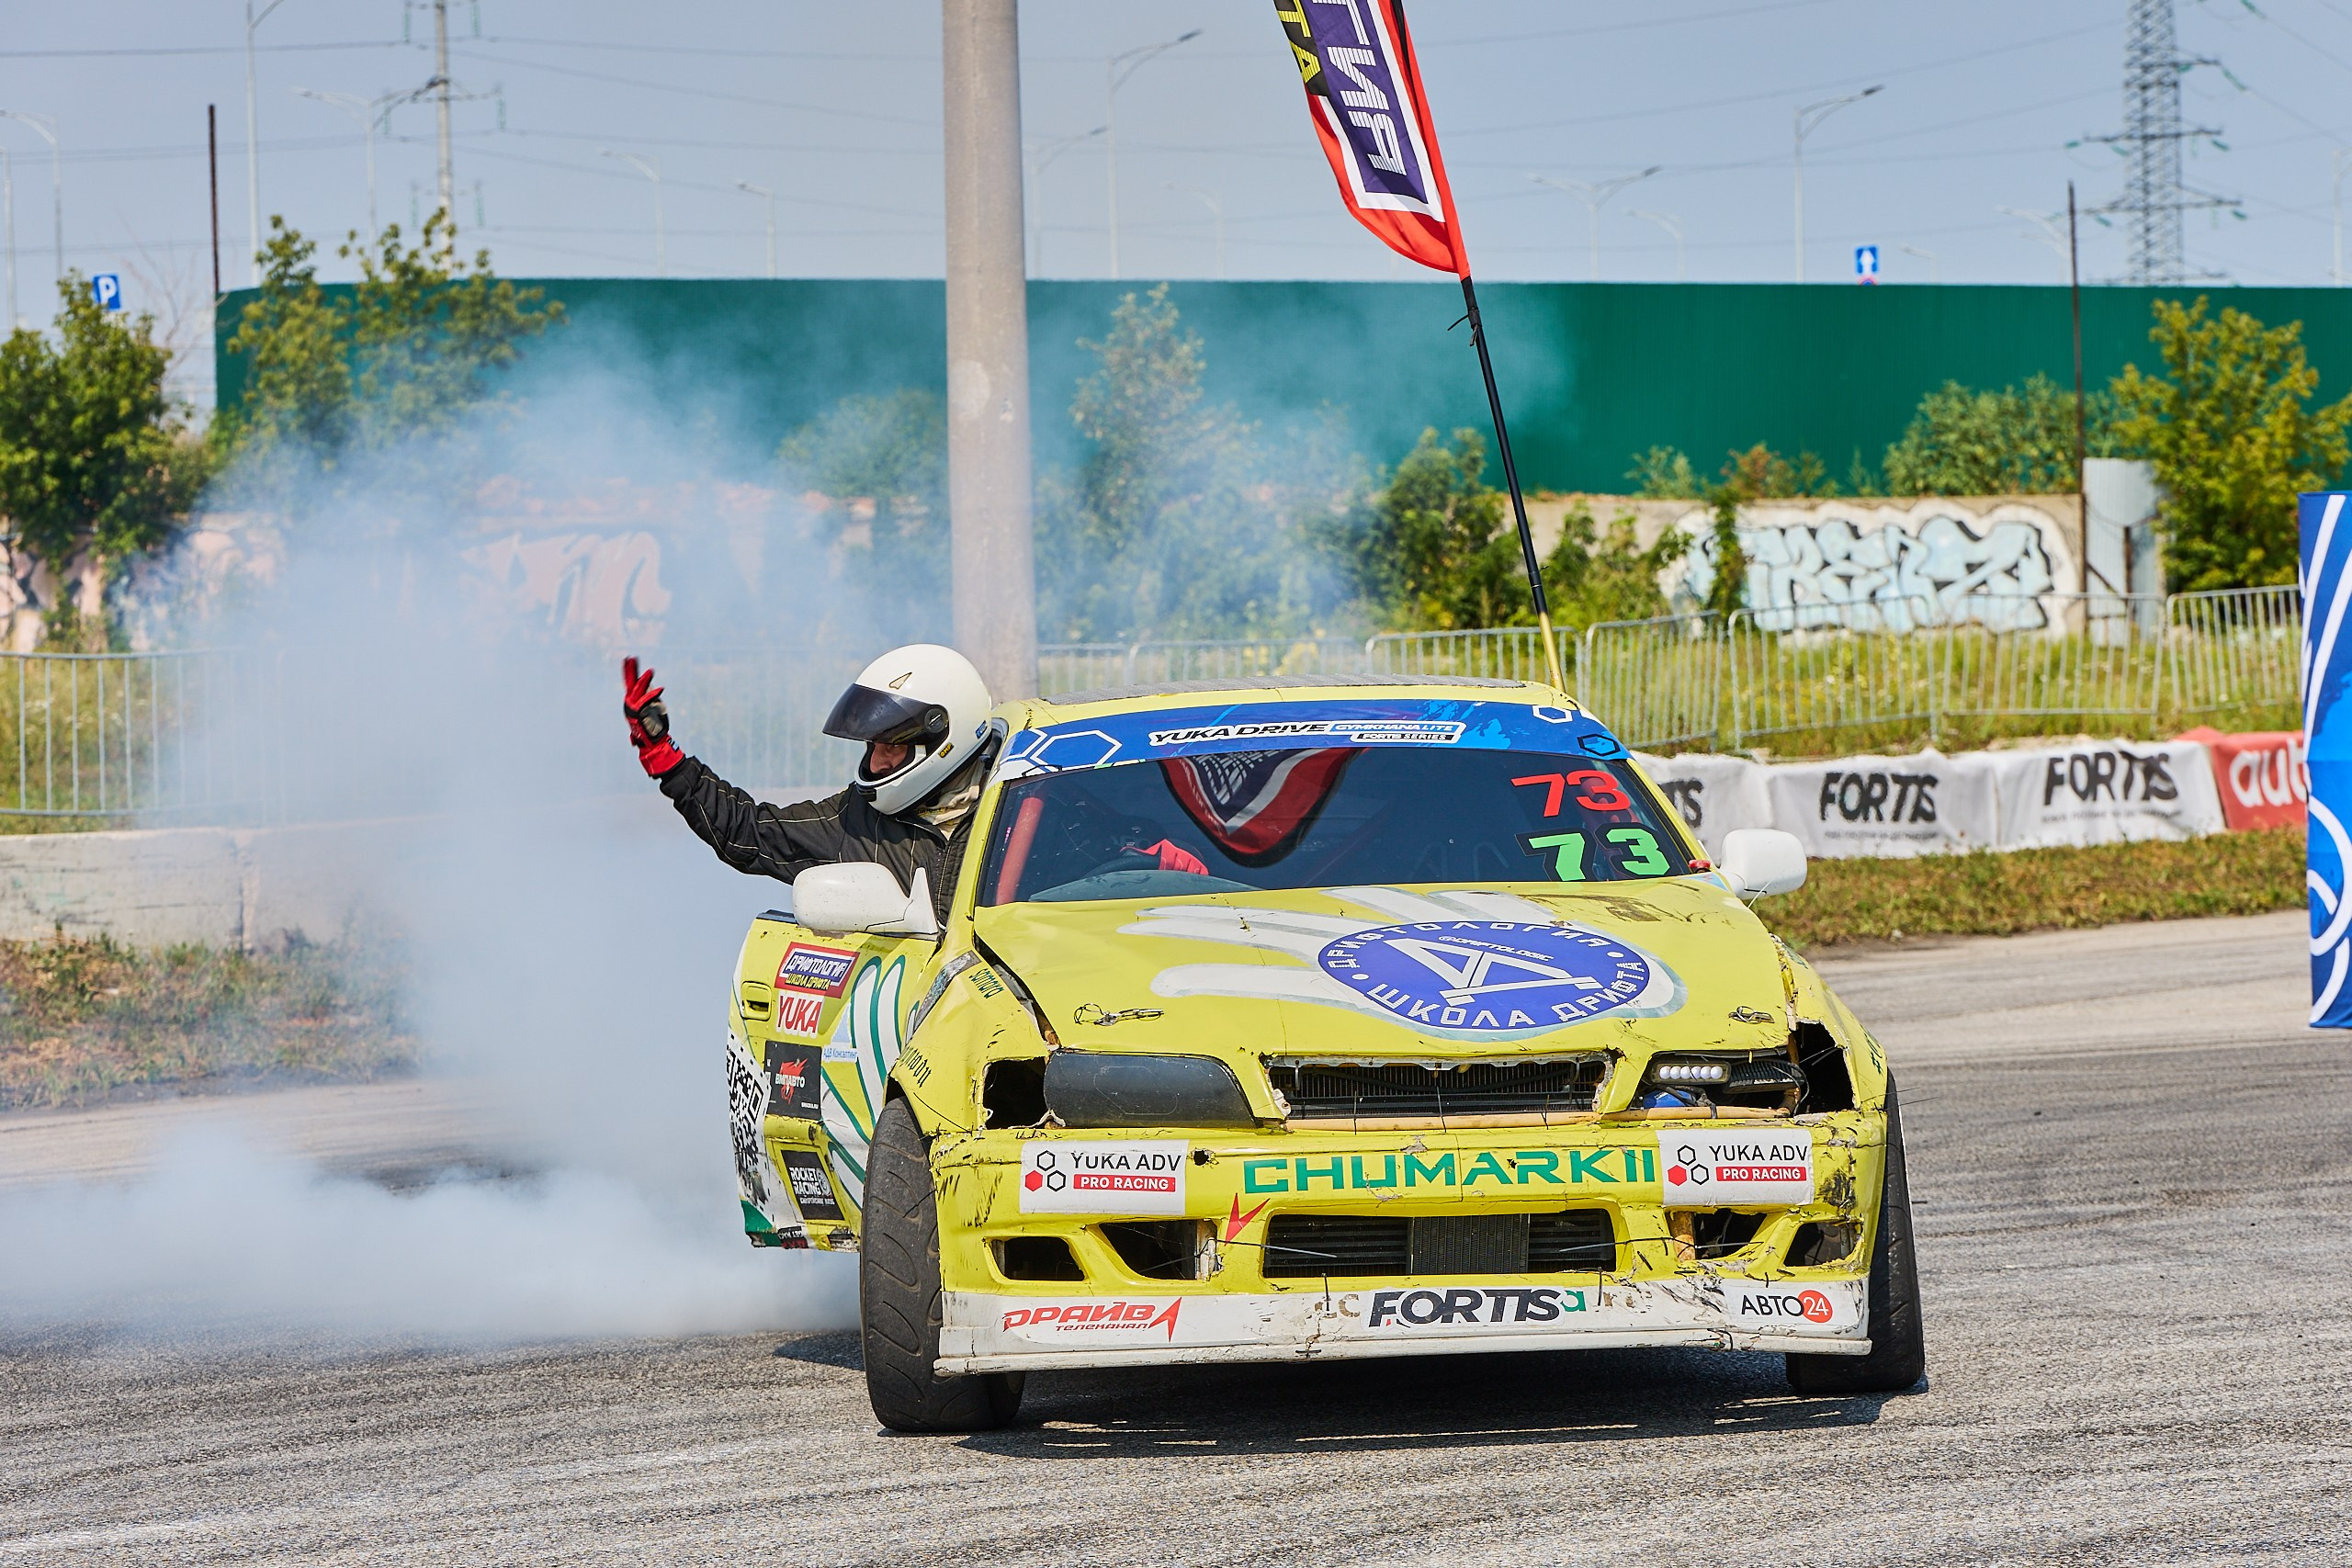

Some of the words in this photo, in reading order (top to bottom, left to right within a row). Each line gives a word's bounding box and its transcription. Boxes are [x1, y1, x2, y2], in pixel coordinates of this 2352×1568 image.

[97, 276, 118, 305] P
[1156, 728, 1230, 743] YUKA
[1236, 723, 1329, 736] DRIVE
[1423, 724, 1454, 732] LITE
[1404, 733, 1447, 741] SERIES
[1510, 770, 1632, 818] 73
[2044, 750, 2179, 807] FORTIS
[1819, 772, 1939, 824] FORTIS
[1529, 829, 1670, 882] 73
[1327, 921, 1611, 969] ДРИФТОЛОГИЯ
[1367, 983, 1536, 1028] ШКОЛА
[1551, 961, 1645, 1022] ДРИФТА
[777, 995, 823, 1033] YUKA
[1070, 1151, 1131, 1170] YUKA
[1136, 1154, 1182, 1172] ADV
[1708, 1145, 1766, 1161] YUKA
[1769, 1145, 1808, 1161] ADV
[789, 1167, 818, 1182] ROCKET
[1080, 1176, 1110, 1188] PRO
[1114, 1177, 1169, 1190] RACING
[1722, 1168, 1749, 1179] PRO
[1752, 1168, 1801, 1180] RACING
[1002, 1301, 1156, 1332] ДРАЙВ
[1369, 1288, 1561, 1327] FORTIS
